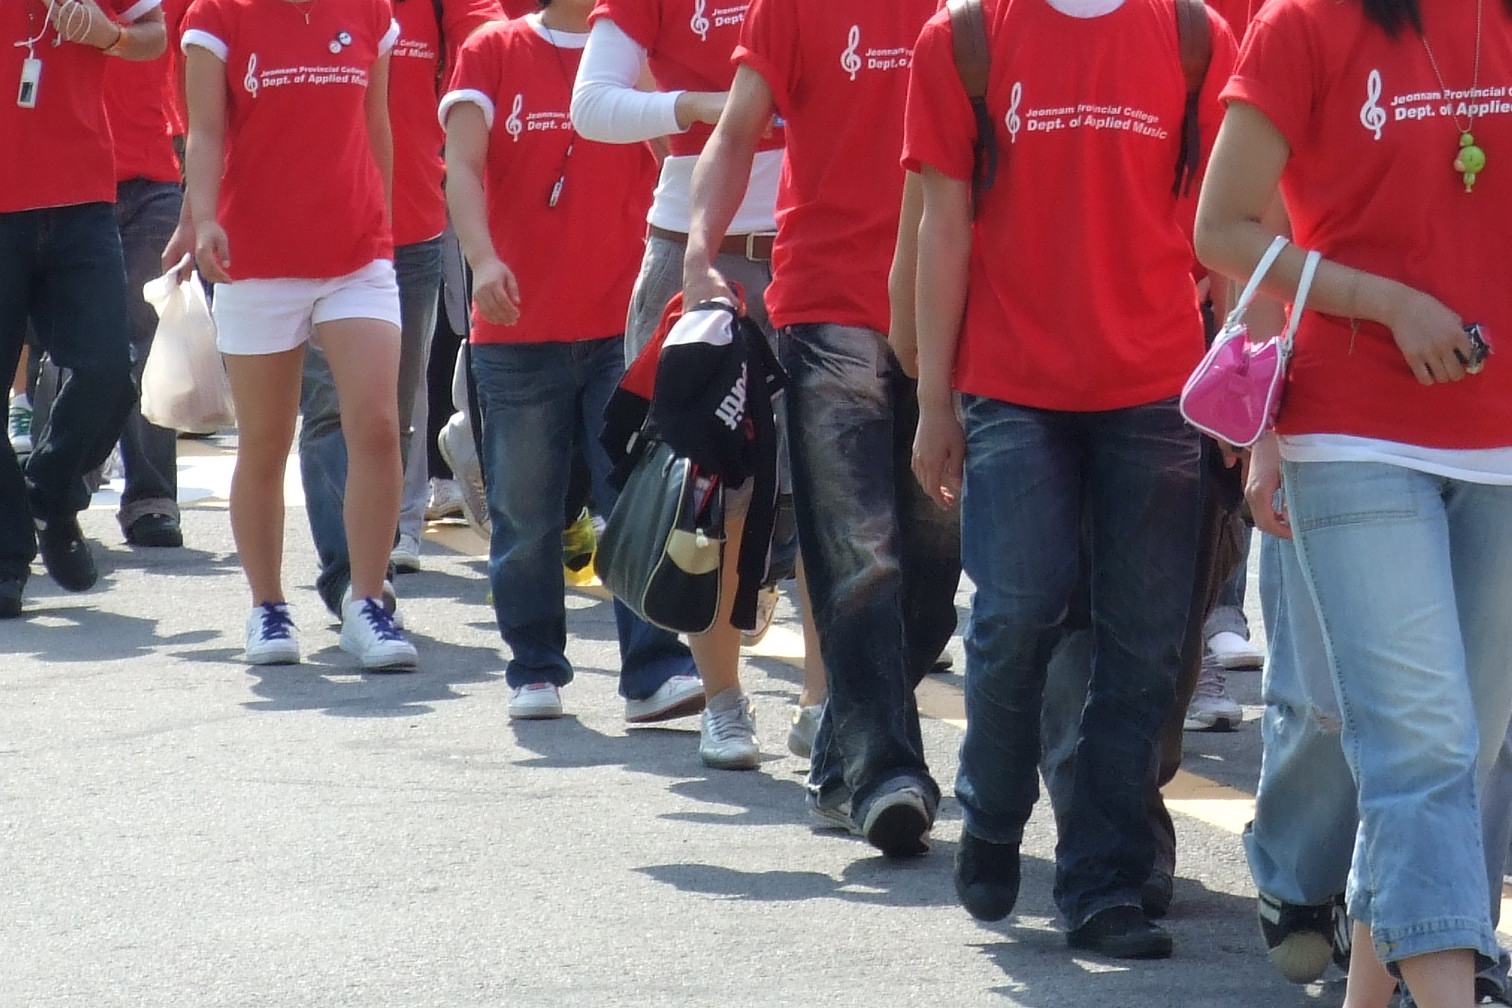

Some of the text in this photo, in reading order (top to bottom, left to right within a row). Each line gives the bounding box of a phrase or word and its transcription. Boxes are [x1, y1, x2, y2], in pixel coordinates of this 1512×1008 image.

[1390, 91, 1441, 107] Jeonnam
[1443, 87, 1506, 100] Provincial
[1025, 106, 1075, 118] Jeonnam
[1395, 104, 1436, 121] Dept.
[1027, 118, 1065, 132] Dept.
[1132, 120, 1168, 140] Music
